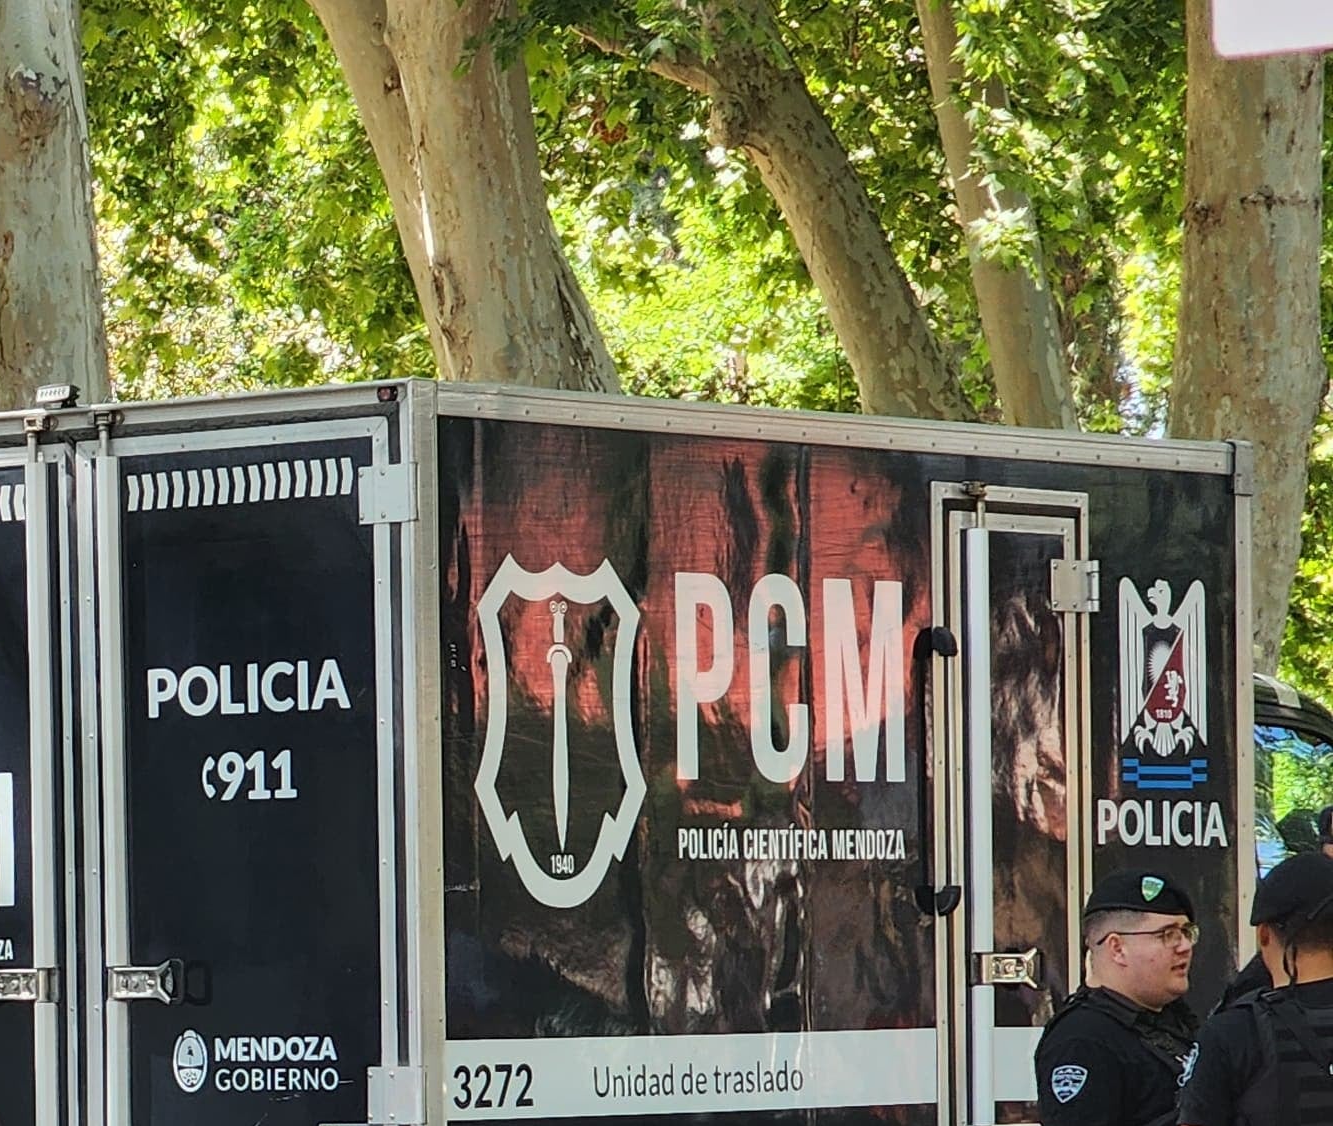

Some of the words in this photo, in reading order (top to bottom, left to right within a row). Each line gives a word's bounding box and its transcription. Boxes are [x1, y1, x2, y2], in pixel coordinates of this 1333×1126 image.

[147, 658, 352, 719] POLICIA
[675, 572, 906, 783] PCM
[217, 749, 298, 801] 911
[677, 822, 739, 860] POLICÍA
[743, 822, 829, 861] CIENTÍFICA
[832, 828, 906, 861] MENDOZA
[1097, 799, 1229, 848] POLICIA
[549, 854, 575, 875] 1940
[214, 1036, 339, 1062] MENDOZA
[214, 1067, 340, 1092] GOBIERNO
[452, 1063, 535, 1110] 3272
[592, 1063, 675, 1099] Unidad
[681, 1062, 709, 1096] de
[713, 1060, 804, 1094] traslado
